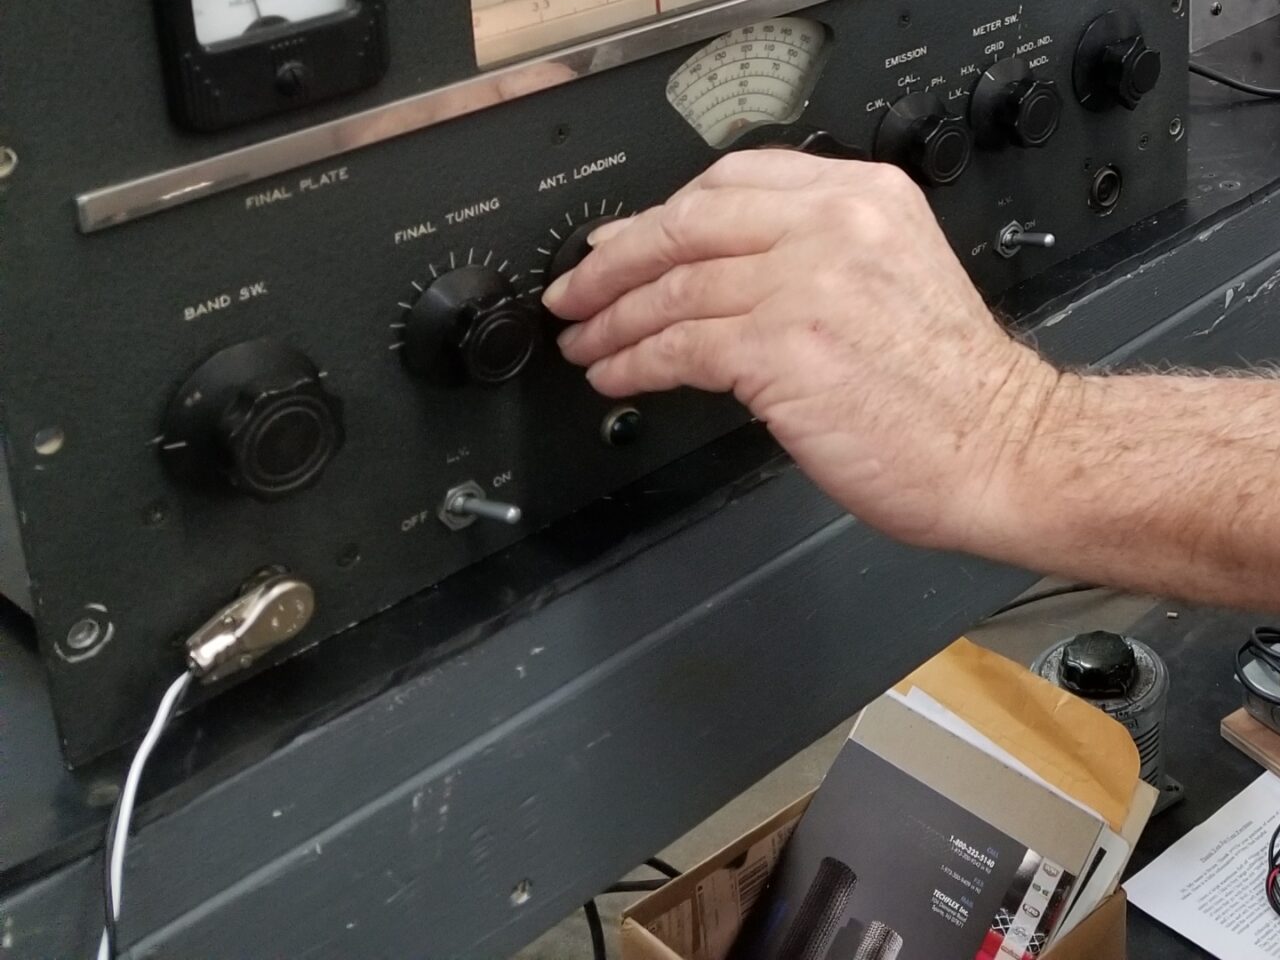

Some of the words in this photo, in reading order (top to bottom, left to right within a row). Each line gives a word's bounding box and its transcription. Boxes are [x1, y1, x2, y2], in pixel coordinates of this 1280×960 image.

[972, 20, 1002, 37] METER
[1004, 14, 1019, 27] SW.
[884, 45, 928, 69] EMISSION
[984, 41, 1005, 55] GRID
[960, 63, 976, 76] H.V.
[1028, 55, 1049, 68] MOD.
[897, 73, 920, 87] CAL.
[931, 74, 946, 87] PH.
[865, 98, 886, 112] C.W.
[538, 172, 567, 192] ANT.
[573, 151, 628, 181] LOADING
[245, 185, 293, 210] FINAL
[299, 166, 350, 192] PLATE
[394, 220, 437, 244] FINAL
[445, 197, 501, 225] TUNING
[184, 293, 231, 321] BAND
[239, 280, 268, 302] SW.
[493, 469, 512, 488] ON
[401, 509, 429, 532] OFF
[932, 888, 959, 910] TECHFLEX
